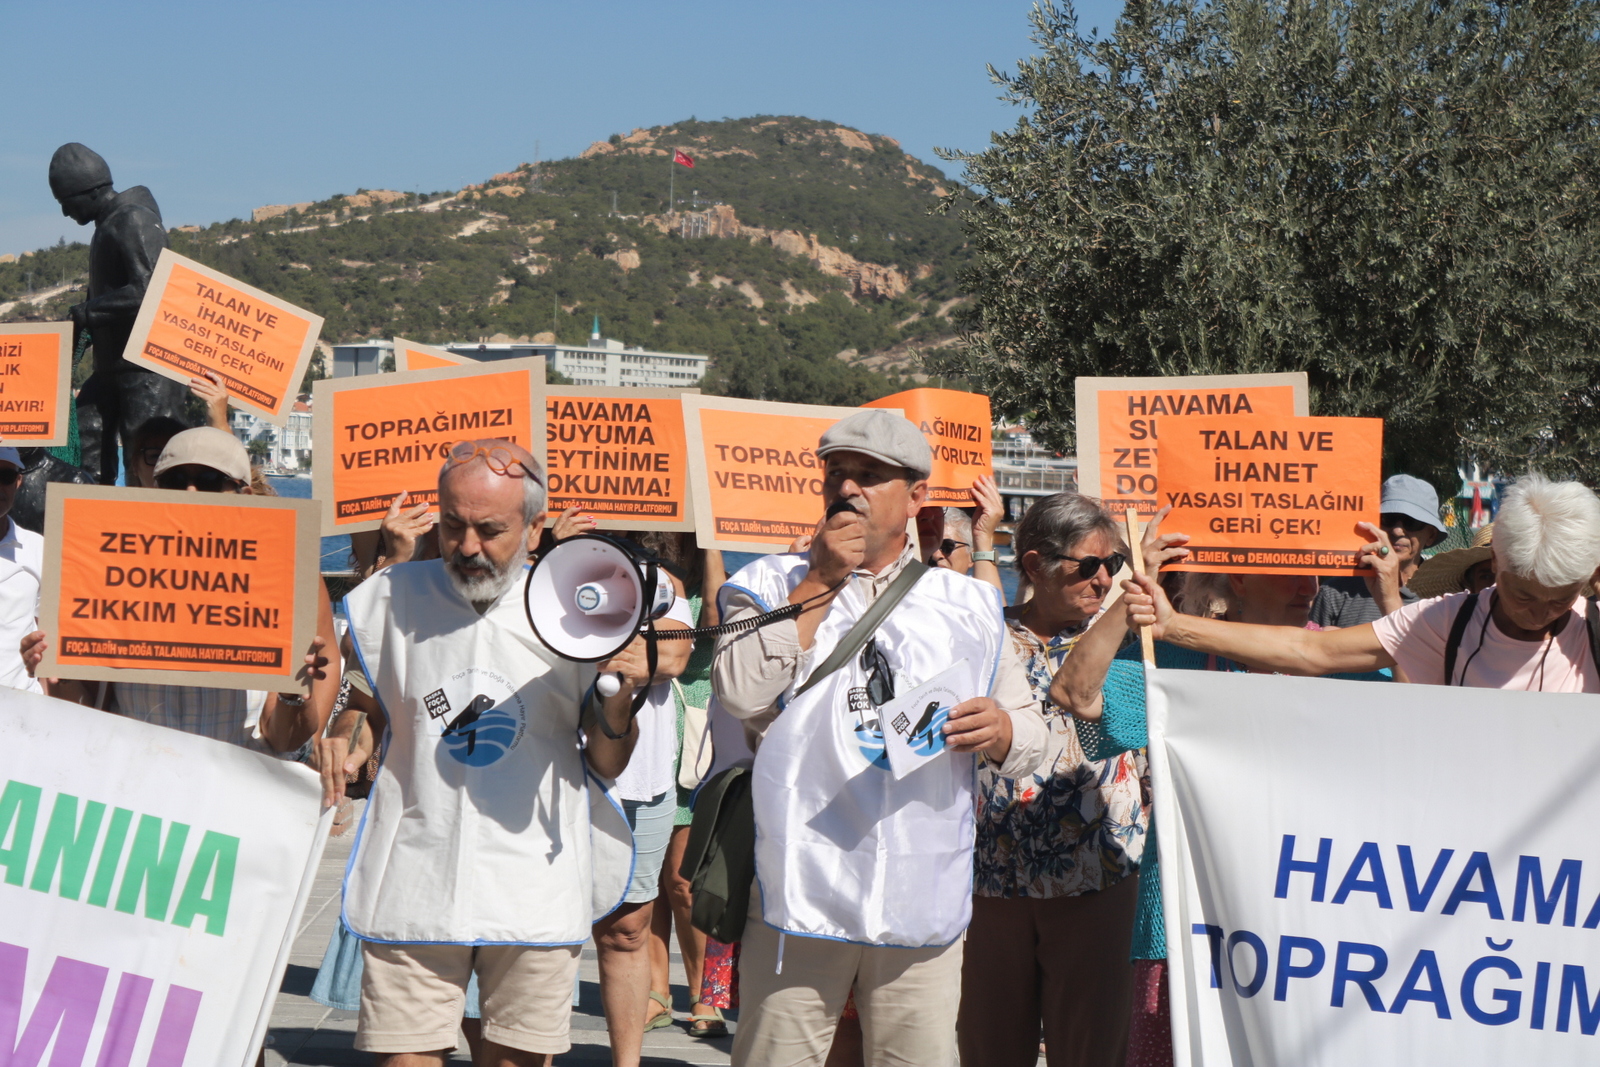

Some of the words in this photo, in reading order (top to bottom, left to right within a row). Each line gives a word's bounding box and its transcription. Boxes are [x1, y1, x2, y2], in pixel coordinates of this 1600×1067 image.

[196, 282, 250, 317] TALAN
[256, 308, 278, 329] VE
[197, 302, 262, 342] İHANET
[0, 342, 22, 357] İZİ
[163, 311, 211, 339] YASASI
[215, 333, 284, 372] TASLAĞINI
[184, 338, 218, 359] GERİ
[221, 354, 253, 375] ÇEK!
[149, 346, 163, 358] FOÇA
[163, 350, 180, 364] TARİH
[185, 360, 200, 373] DOĞA
[242, 386, 273, 405] PLATFORMU
[546, 401, 652, 422] HAVAMA
[1128, 393, 1253, 416] HAVAMA
[345, 408, 512, 441] TOPRAĞIMIZI
[547, 423, 655, 445] SUYUMA
[920, 416, 981, 442] AĞIMIZI
[1199, 430, 1288, 450] TALAN
[1297, 431, 1334, 451] VE
[930, 445, 986, 466] YORUZ!
[1214, 457, 1318, 483] İHANET
[548, 474, 671, 497] OKUNMA!
[928, 489, 969, 500] DEMOKRASİ
[341, 500, 360, 515] FOÇA
[361, 496, 382, 511] TARİH
[382, 499, 391, 507] ve
[581, 501, 613, 511] TALANINA
[614, 503, 634, 512] HAYIR
[634, 503, 672, 513] PLATFORMU
[1109, 502, 1128, 513] FOÇA
[1166, 492, 1243, 509] YASASI
[1251, 490, 1363, 512] TASLAĞINI
[720, 521, 739, 533] FOÇA
[740, 521, 761, 533] TARİH
[771, 523, 790, 534] DOĞA
[1209, 515, 1261, 534] GERİ
[1269, 518, 1321, 539] ÇEK!
[100, 530, 257, 561] ZEYTİNİME
[1197, 551, 1229, 563] EMEK
[1232, 555, 1245, 563] ve
[1248, 551, 1316, 565] DEMOKRASİ
[105, 566, 250, 594] DOKUNAN
[71, 598, 176, 623] ZIKKIM
[187, 601, 279, 629] YESİN!
[66, 641, 89, 655] FOÇA
[91, 640, 116, 654] TARİH
[117, 646, 128, 655] ve
[129, 642, 152, 656] DOĞA
[154, 645, 197, 658] TALANINA
[199, 648, 224, 660] HAYIR
[225, 650, 275, 663] PLATFORMU
[451, 671, 466, 681] Foça
[489, 672, 504, 684] Doğa
[428, 695, 445, 709] FOÇA
[849, 693, 868, 701] FOÇA
[850, 701, 869, 710] YOK
[430, 702, 449, 717] YOK
[0, 779, 240, 937] ANINA
